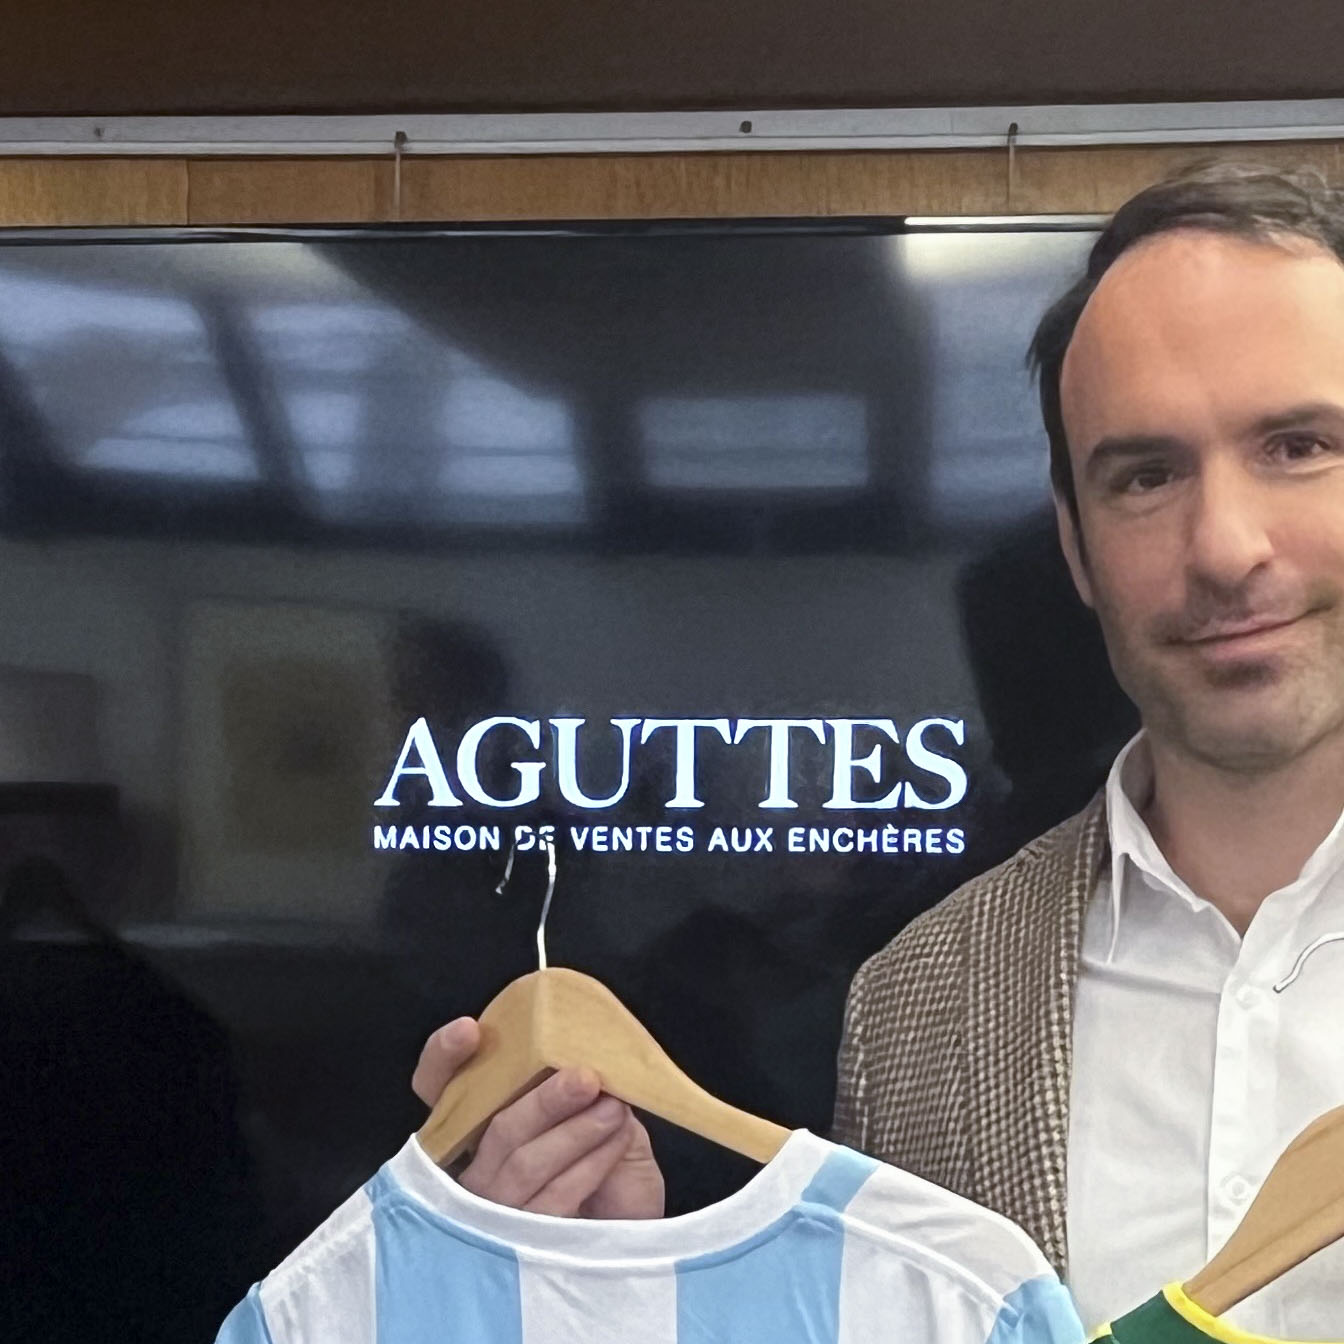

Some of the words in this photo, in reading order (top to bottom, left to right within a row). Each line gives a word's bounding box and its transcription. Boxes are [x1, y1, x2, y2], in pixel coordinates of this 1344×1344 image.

[373, 716, 968, 810] AGUTTES
[373, 825, 500, 851] MAISON
[514, 825, 555, 851] DE
[571, 826, 694, 853] VENTES
[708, 827, 773, 853] AUX
[788, 822, 966, 854] ENCHÈRES
